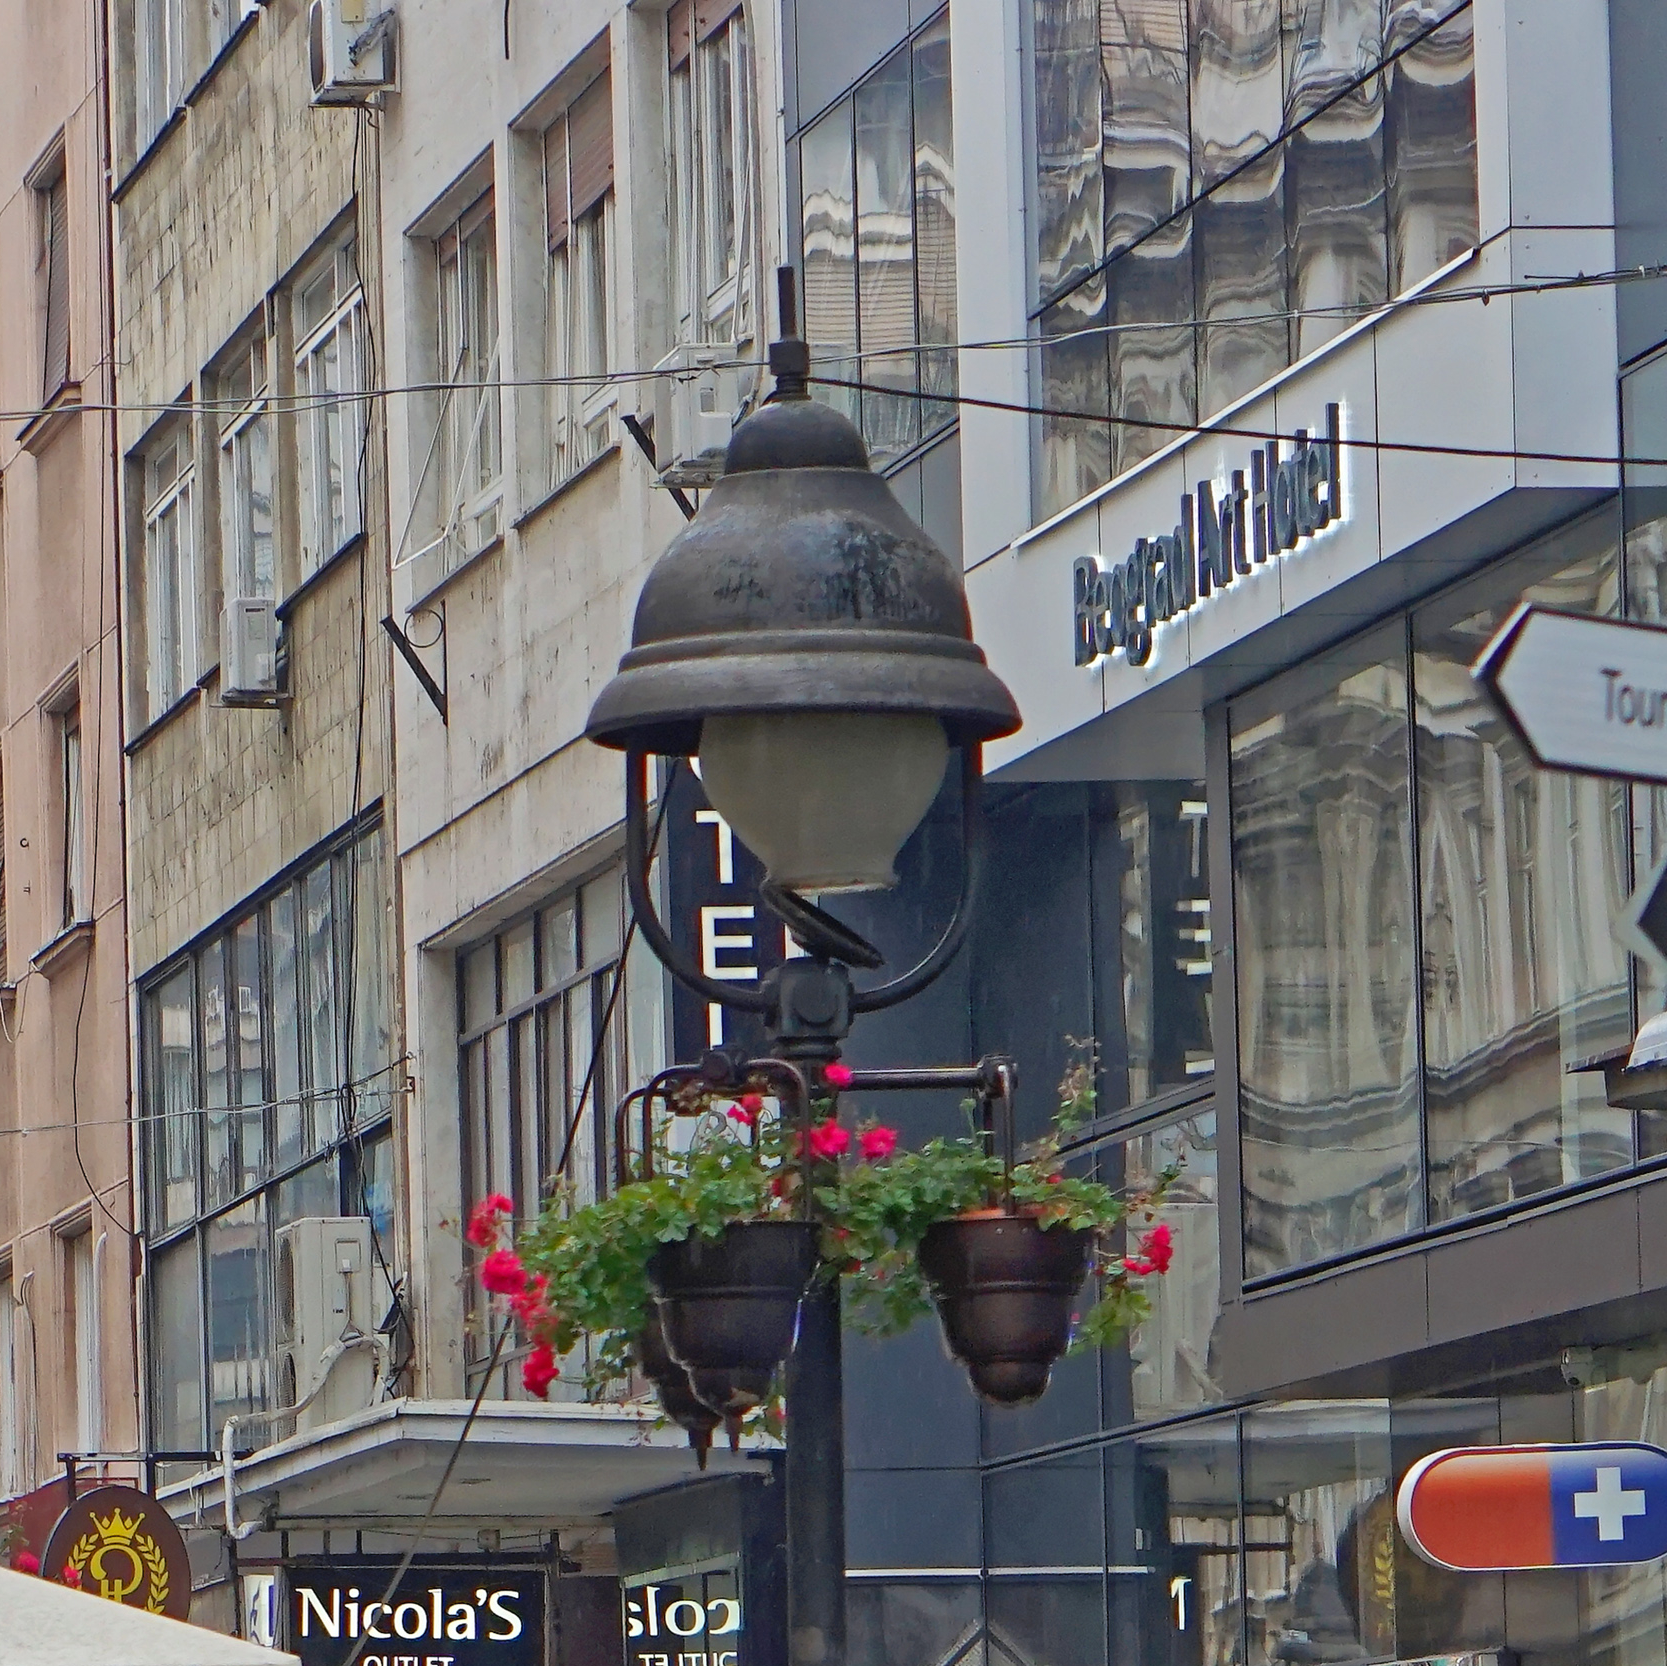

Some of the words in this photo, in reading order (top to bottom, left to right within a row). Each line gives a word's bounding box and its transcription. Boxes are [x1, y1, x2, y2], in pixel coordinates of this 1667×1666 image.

[1073, 494, 1196, 666] Beograd
[1198, 470, 1251, 596] Art
[1251, 403, 1341, 562] Hotel
[295, 1588, 523, 1640] Nicola'S
